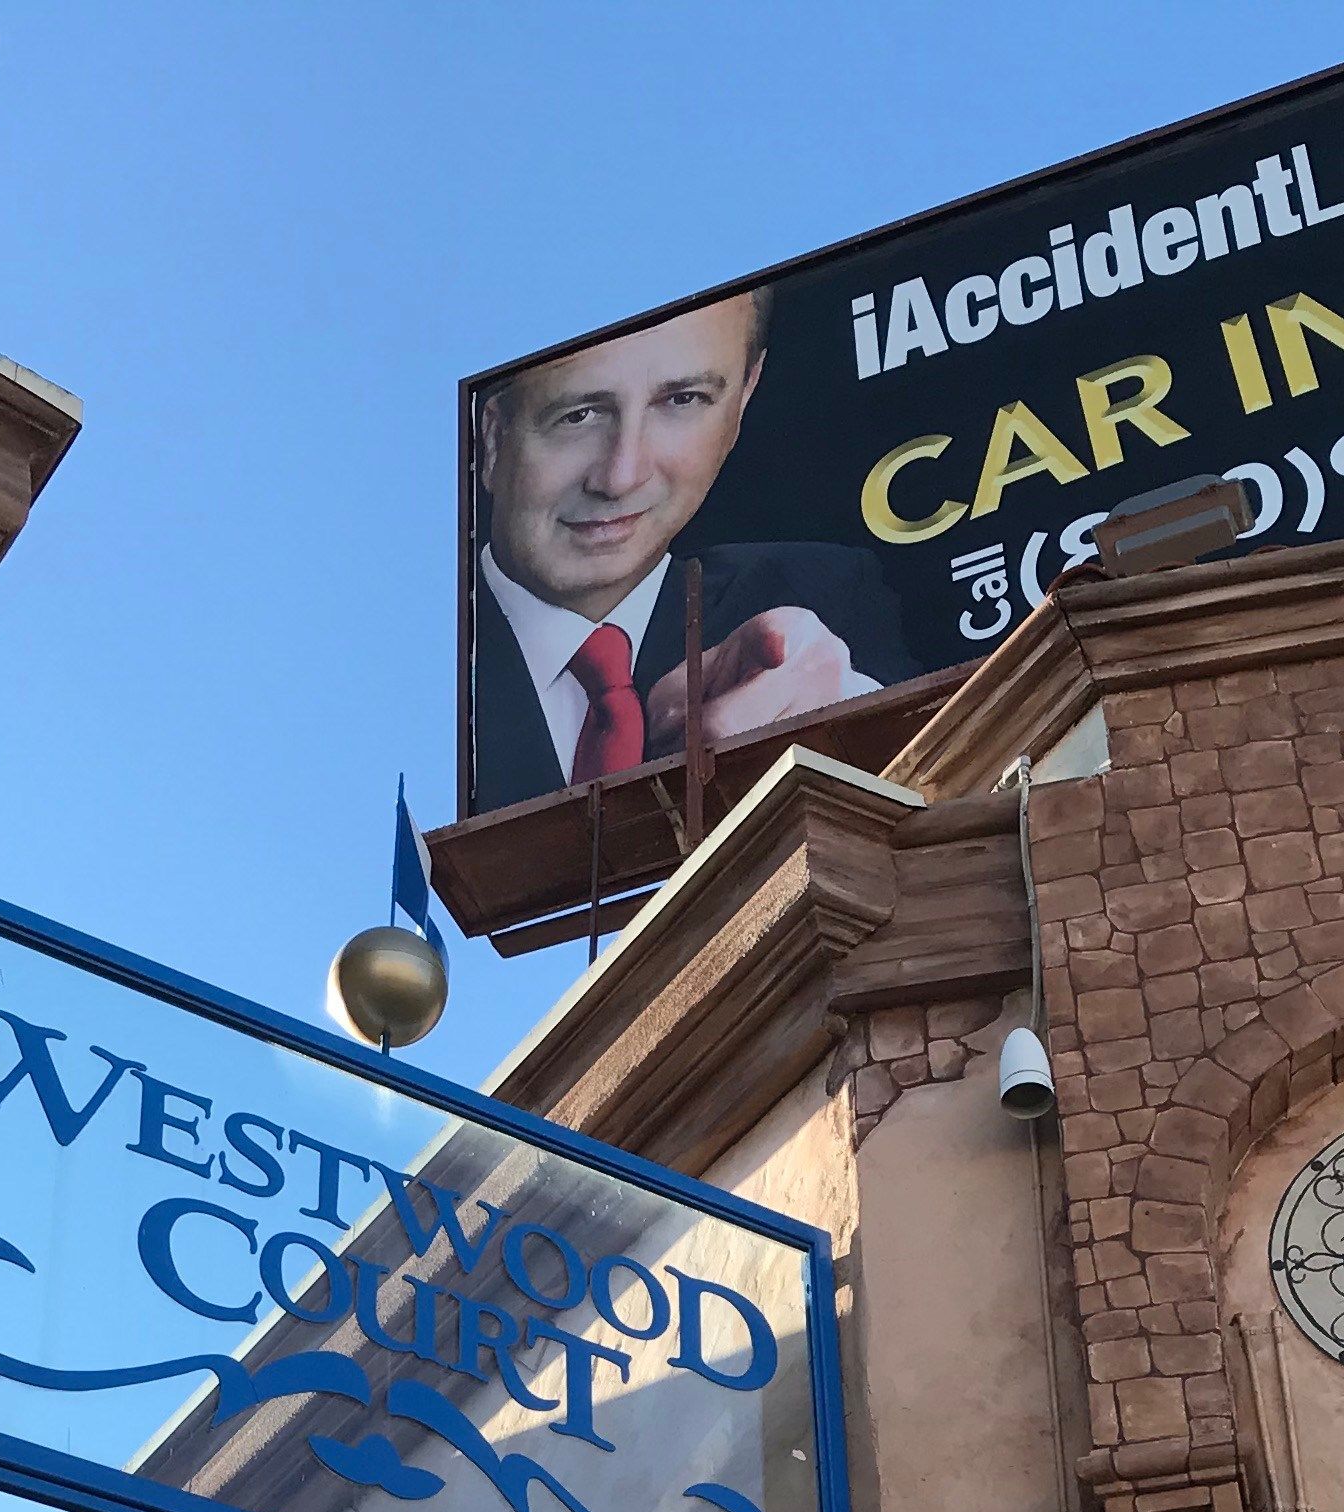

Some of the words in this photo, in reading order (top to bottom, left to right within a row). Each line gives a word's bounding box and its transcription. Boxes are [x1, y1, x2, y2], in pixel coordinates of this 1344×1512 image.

[860, 354, 1192, 545] CAR
[950, 542, 1012, 640] Call
[138, 1197, 630, 1453] COURT
